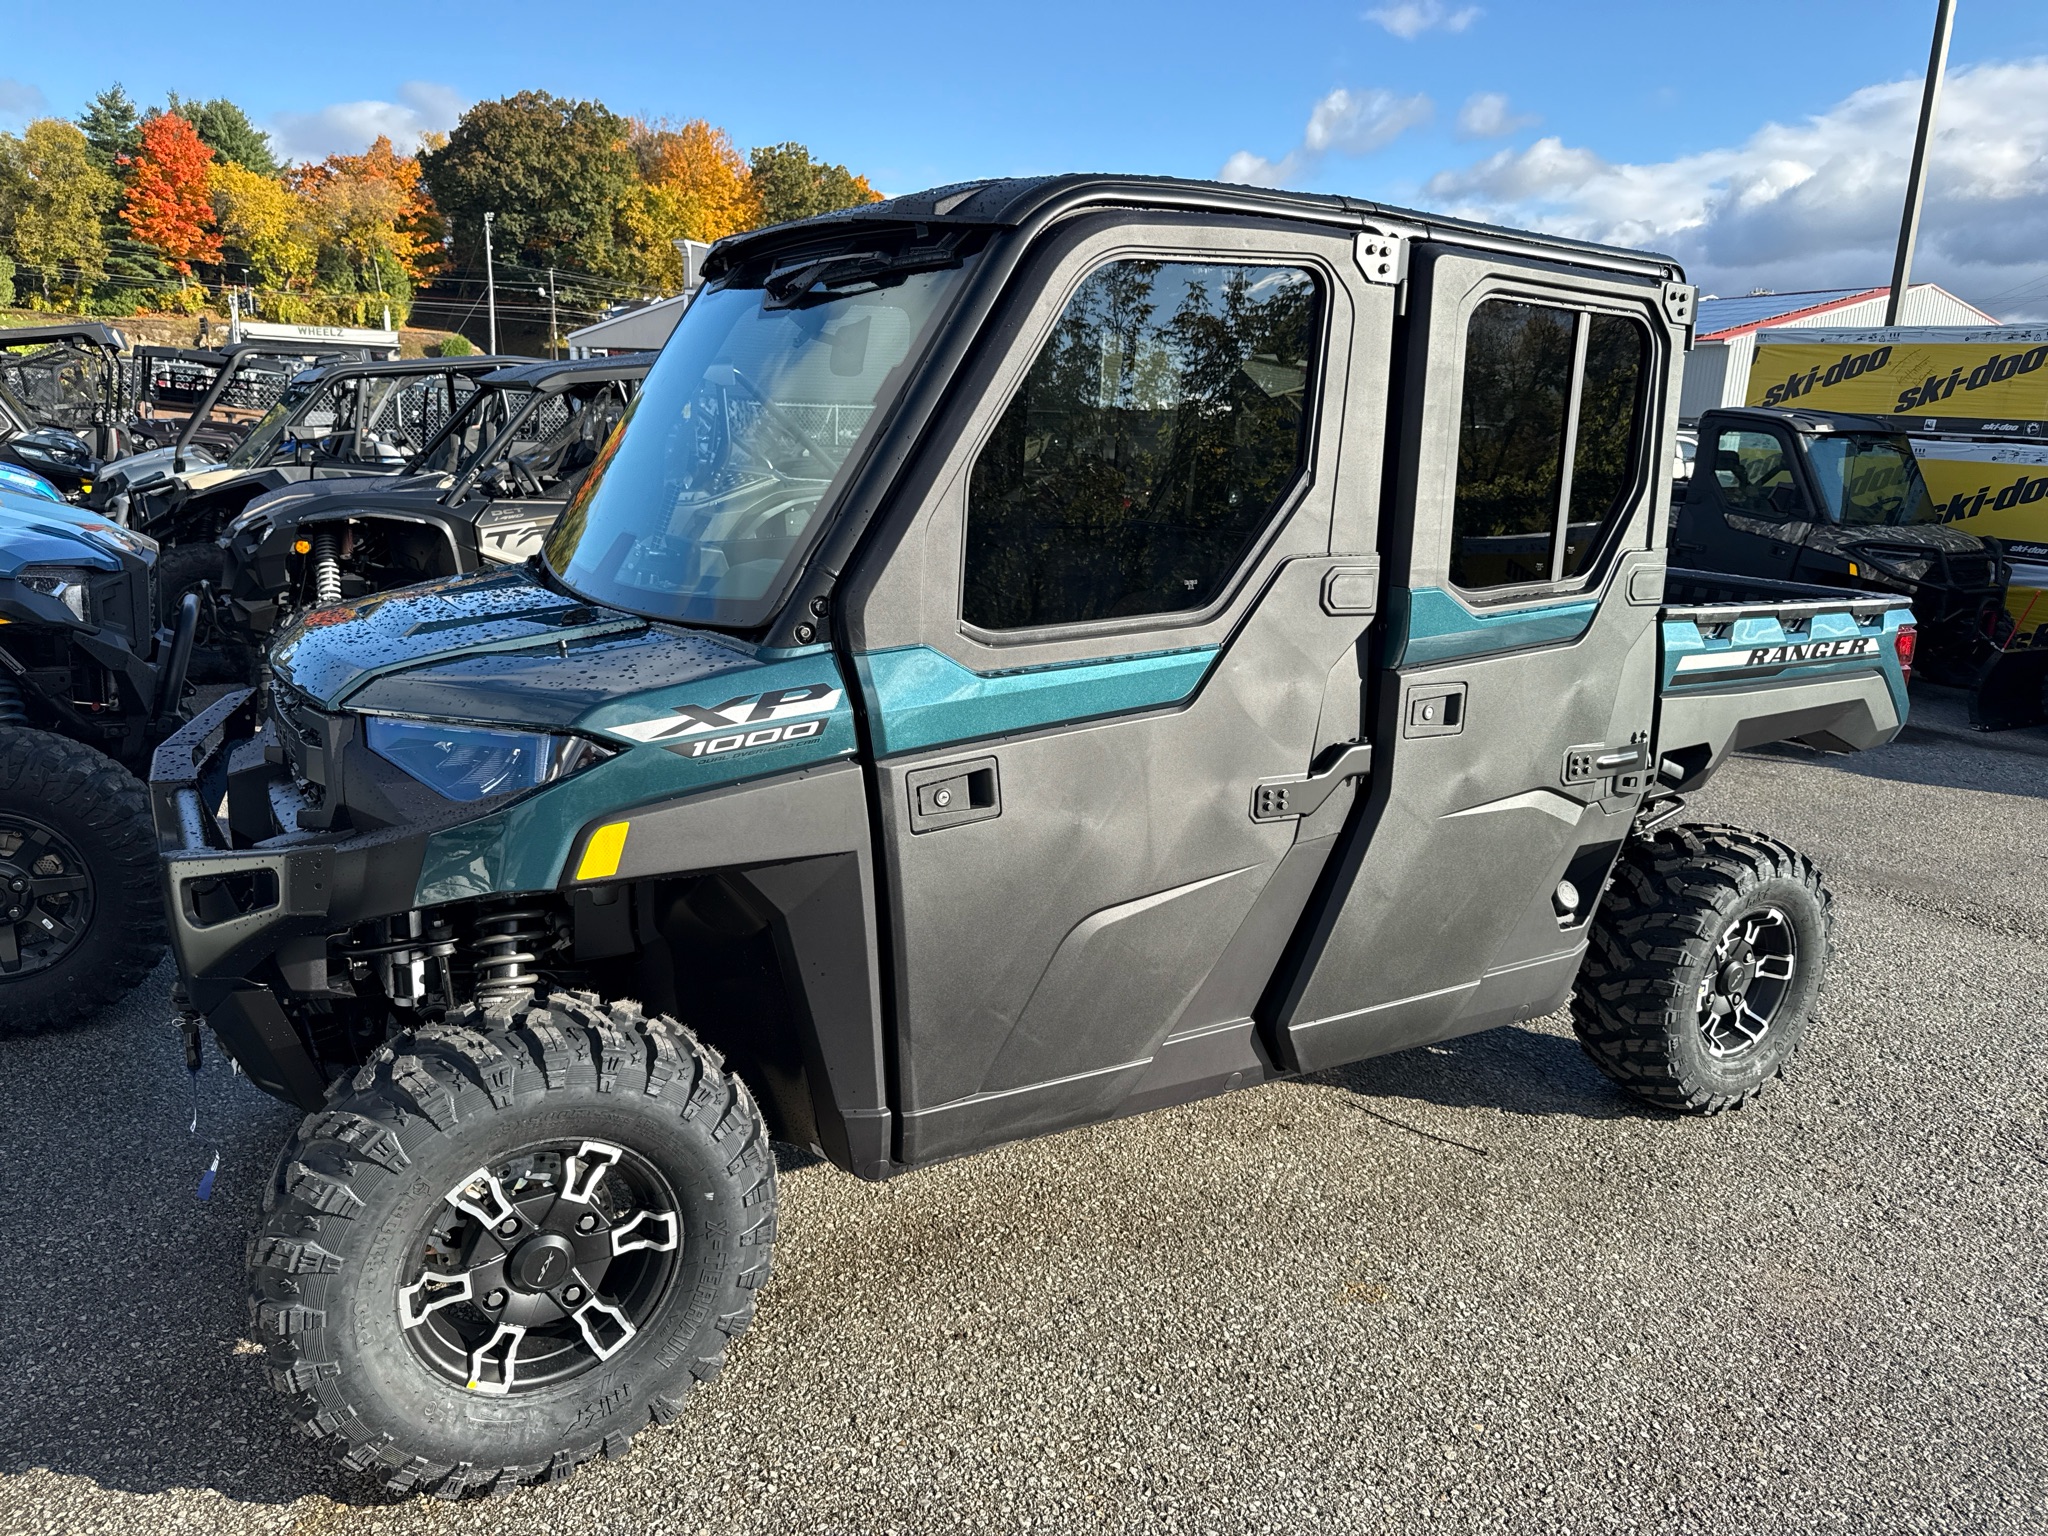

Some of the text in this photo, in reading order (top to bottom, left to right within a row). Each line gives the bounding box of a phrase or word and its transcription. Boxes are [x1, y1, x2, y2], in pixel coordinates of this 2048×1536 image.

[297, 326, 344, 337] WHEELZ
[1762, 346, 1893, 407] ski-doo
[1894, 345, 2048, 413] ski-doo
[1981, 423, 2019, 432] ski-doo
[490, 507, 523, 516] DCT
[1933, 475, 2048, 525] ski-do
[1744, 638, 1869, 666] RANGER
[650, 682, 834, 740] XP
[692, 720, 820, 757] 1000
[654, 1219, 729, 1370] X-TERRAIN
